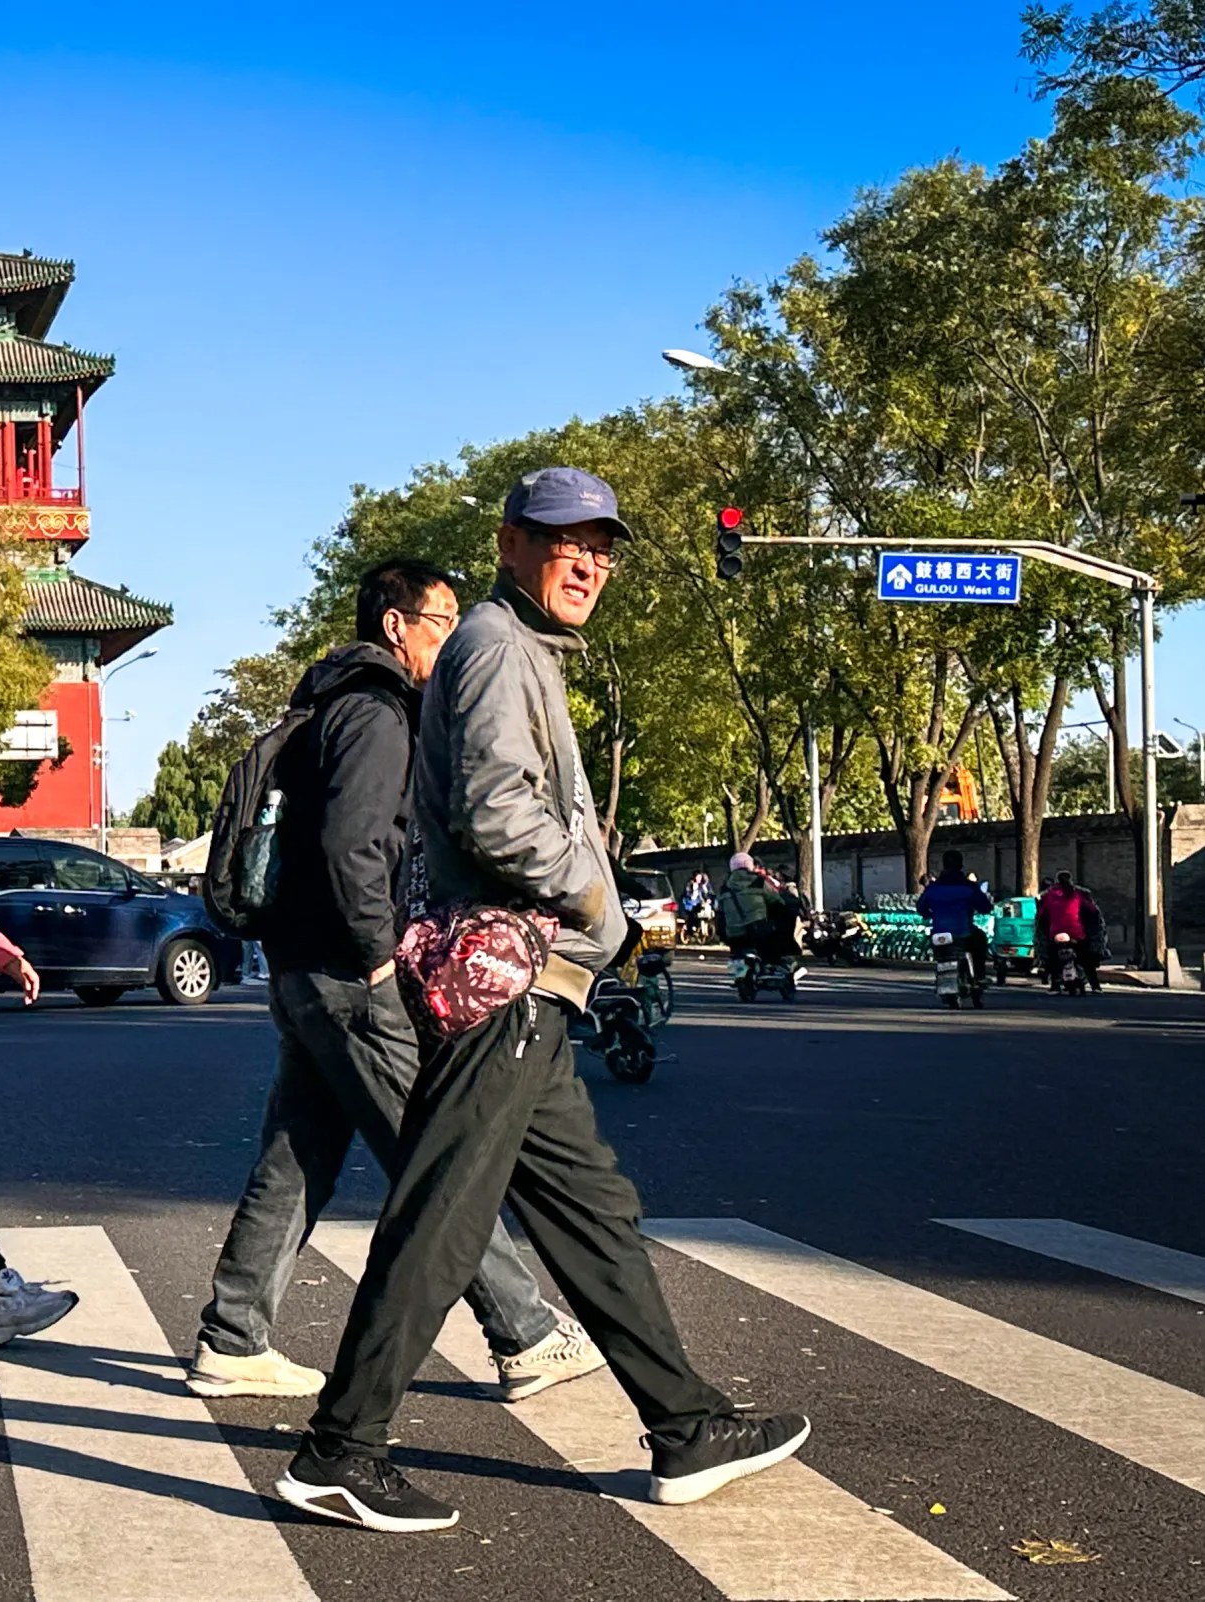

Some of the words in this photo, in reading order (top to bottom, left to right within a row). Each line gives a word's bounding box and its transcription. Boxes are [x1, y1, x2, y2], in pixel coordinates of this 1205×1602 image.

[915, 583, 957, 594] GULOU
[963, 585, 991, 595] West
[997, 586, 1010, 595] St
